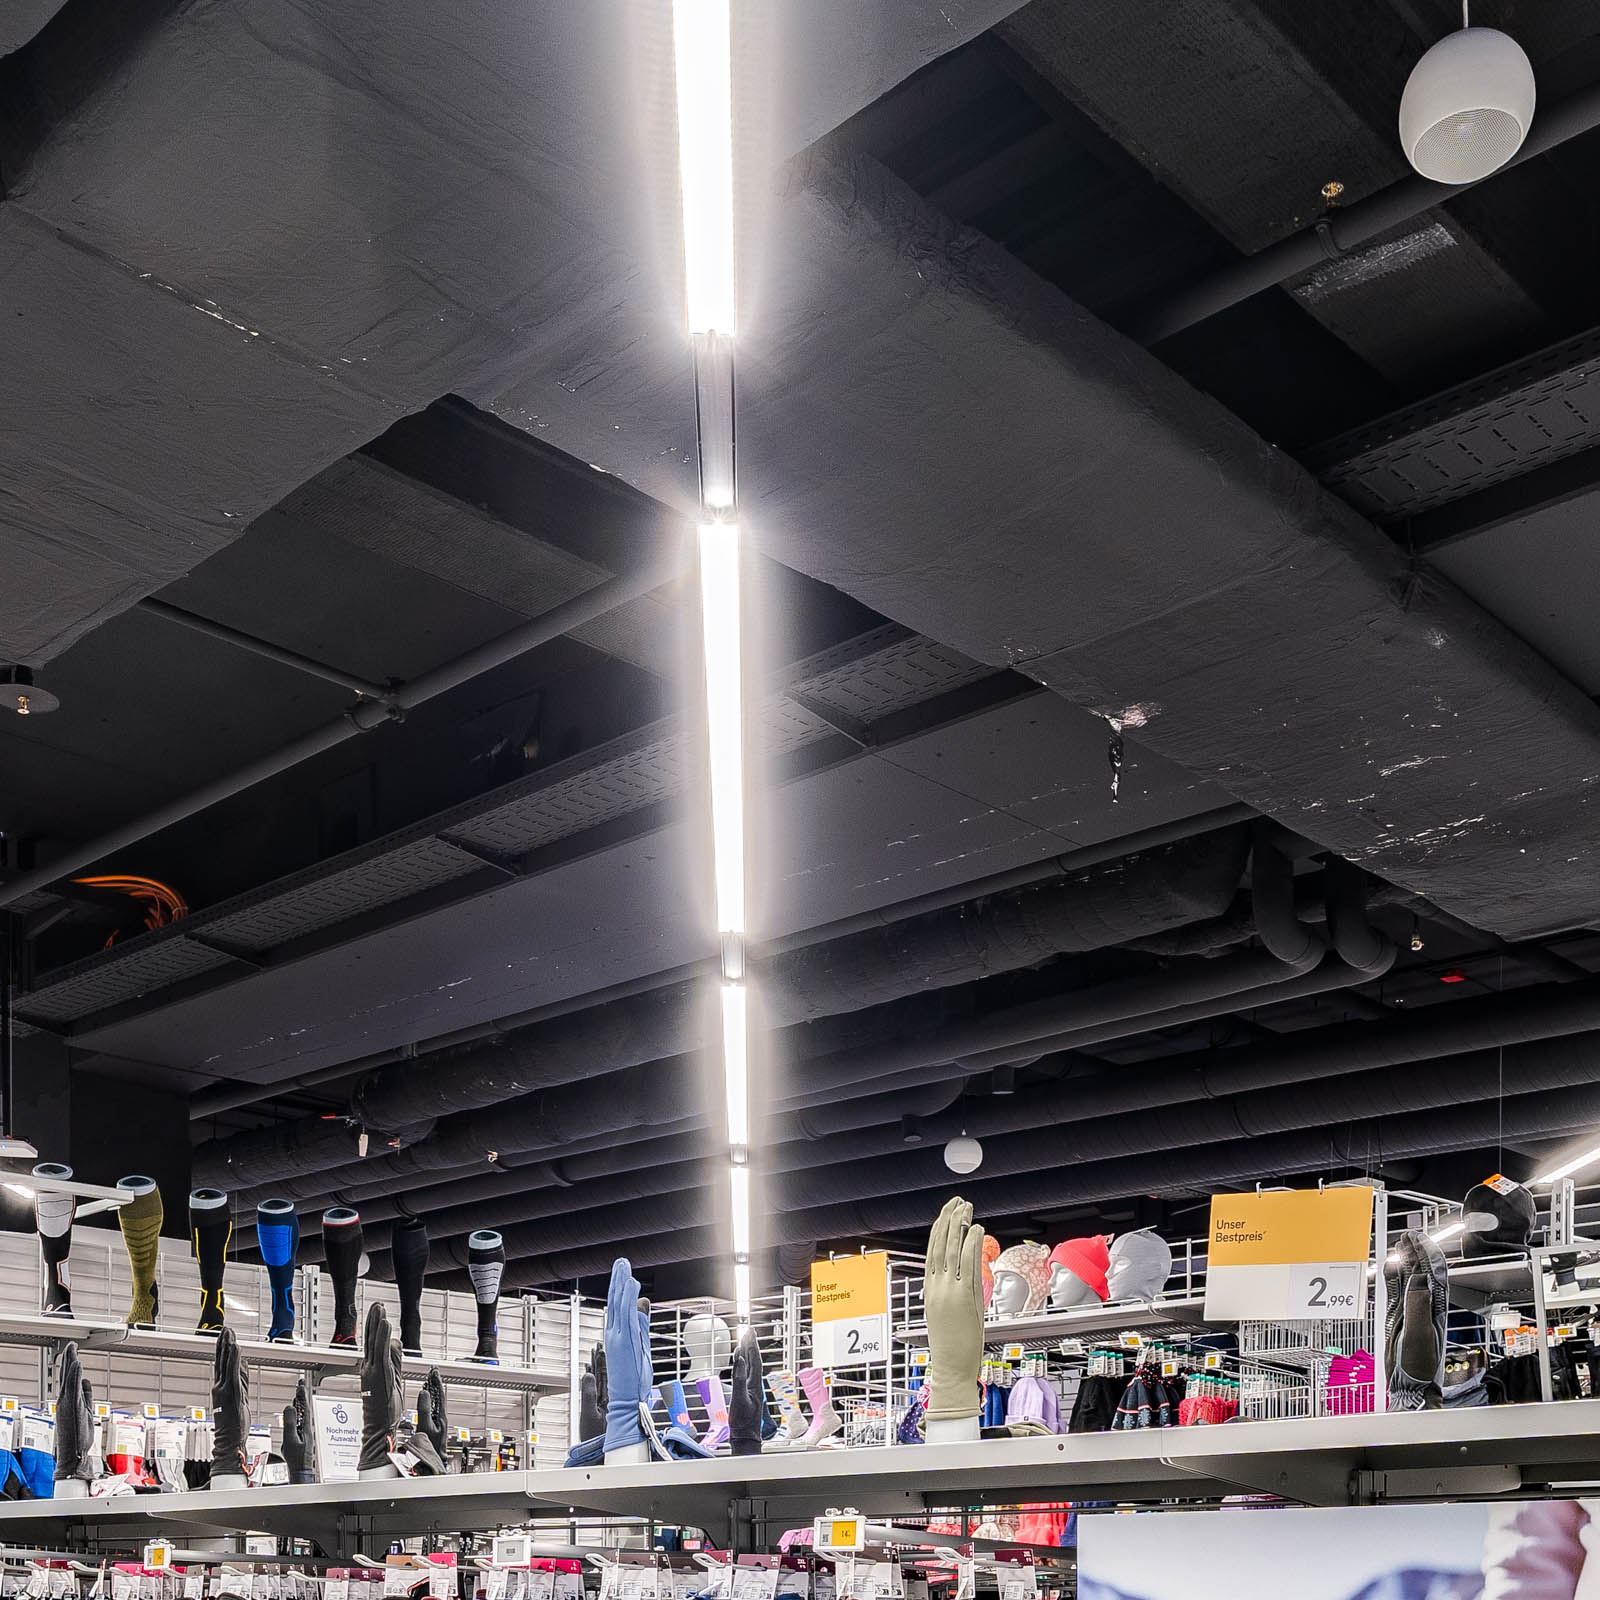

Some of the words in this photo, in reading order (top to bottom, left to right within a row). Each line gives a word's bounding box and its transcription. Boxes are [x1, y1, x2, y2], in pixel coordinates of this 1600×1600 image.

[1216, 1219, 1246, 1230] Unser
[1215, 1231, 1263, 1244] Bestpreis
[816, 1283, 838, 1292] Unser
[1307, 1277, 1354, 1308] 2,99€
[816, 1291, 851, 1303] Bestpreis
[847, 1329, 880, 1355] 2,99€
[326, 1427, 343, 1435] Noch
[343, 1427, 360, 1435] mehr
[330, 1435, 357, 1443] Auswahl
